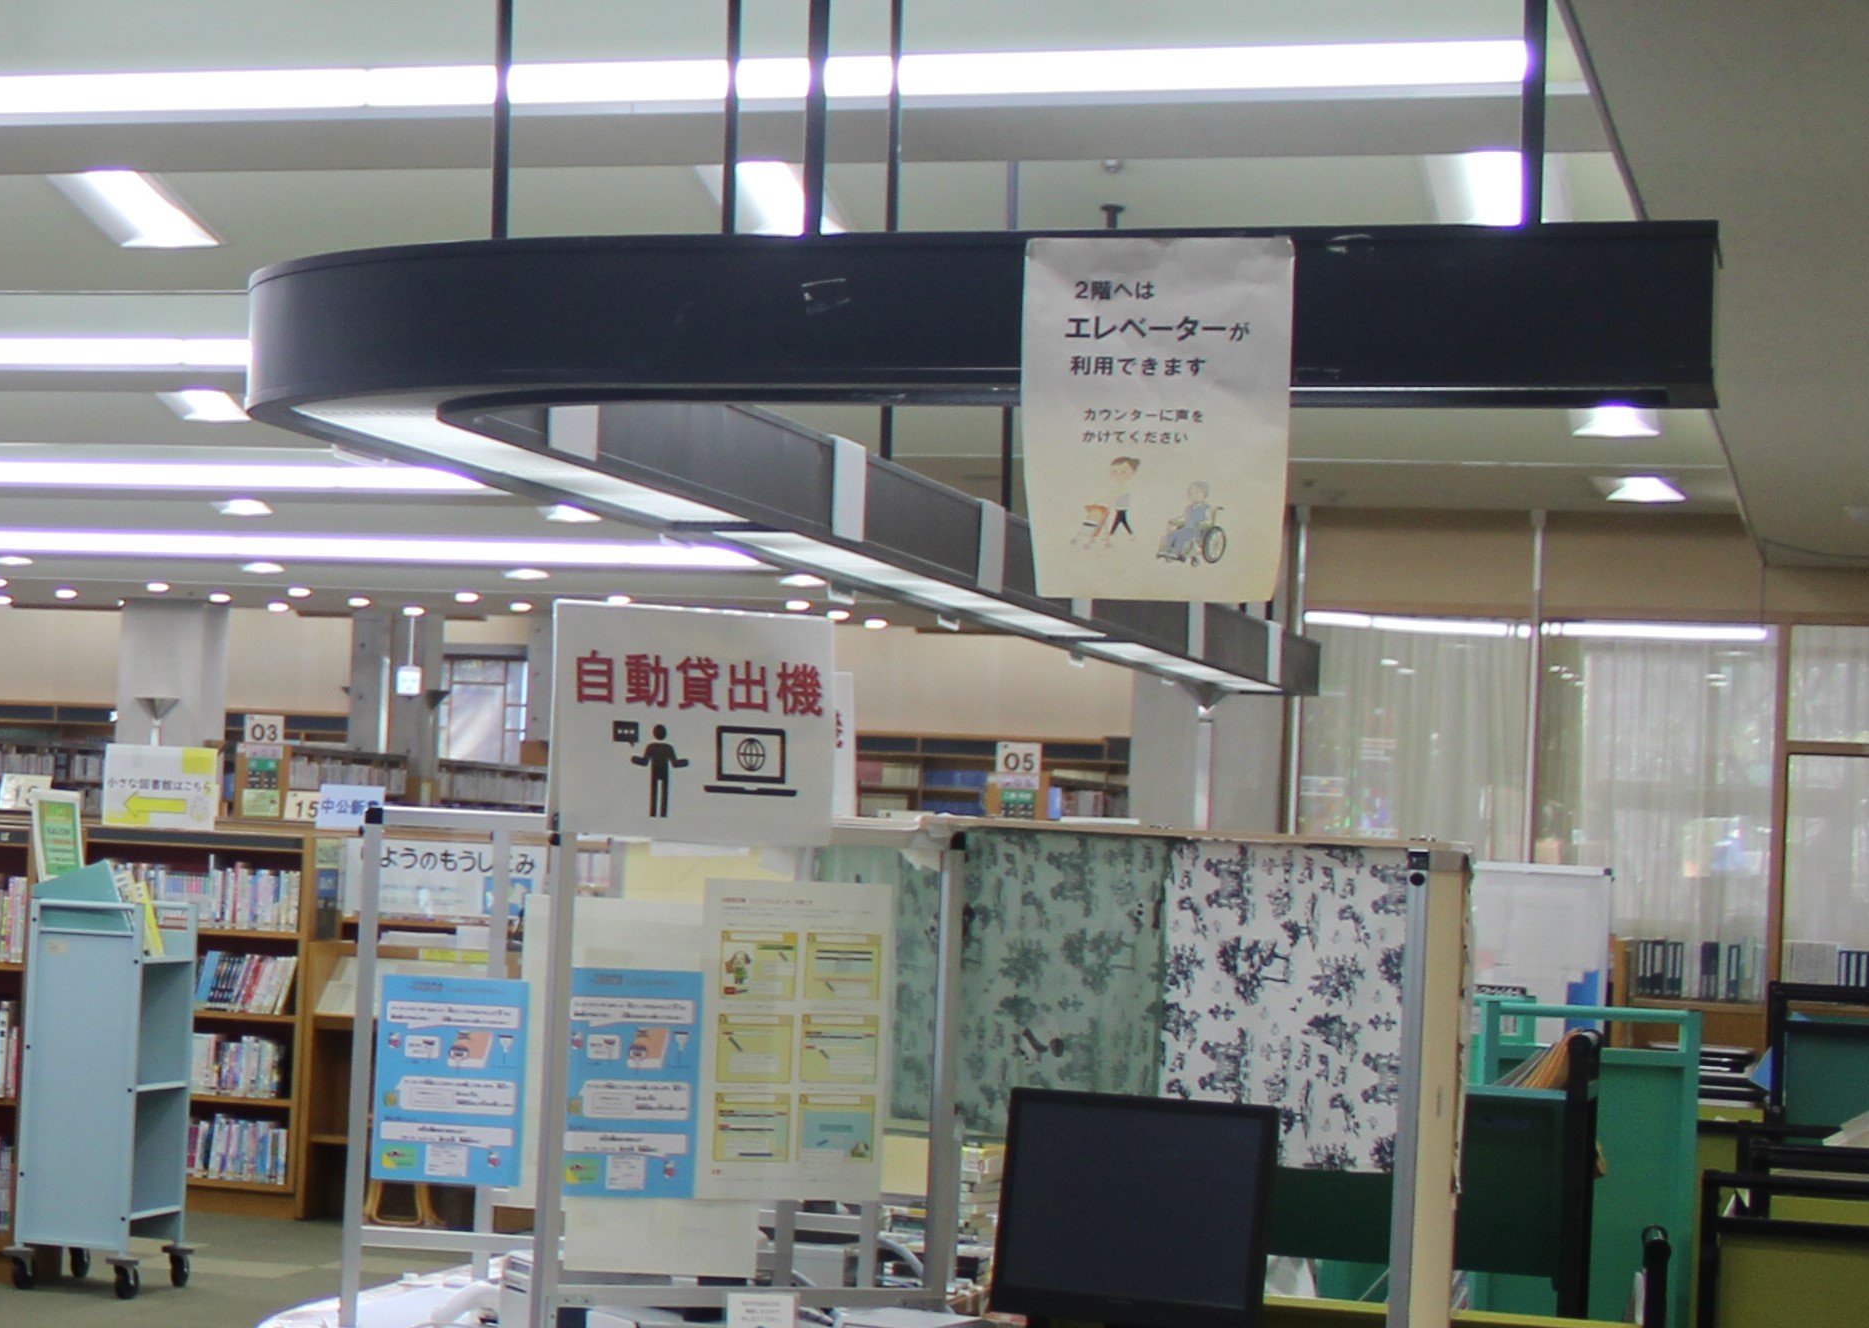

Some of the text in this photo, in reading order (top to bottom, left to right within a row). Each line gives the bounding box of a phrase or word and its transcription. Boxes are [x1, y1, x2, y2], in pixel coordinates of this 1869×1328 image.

[1074, 280, 1155, 301] 2階へは
[1064, 314, 1250, 343] エレベーターが
[1069, 355, 1207, 377] 利用できます
[1083, 407, 1205, 425] カウンターに声を
[1081, 430, 1189, 446] かけてください
[575, 649, 825, 718] 自動貸出機
[250, 723, 279, 740] 03
[1004, 752, 1035, 772] 05
[107, 777, 212, 794] 小さな図書館はこちら
[296, 801, 319, 818] 15
